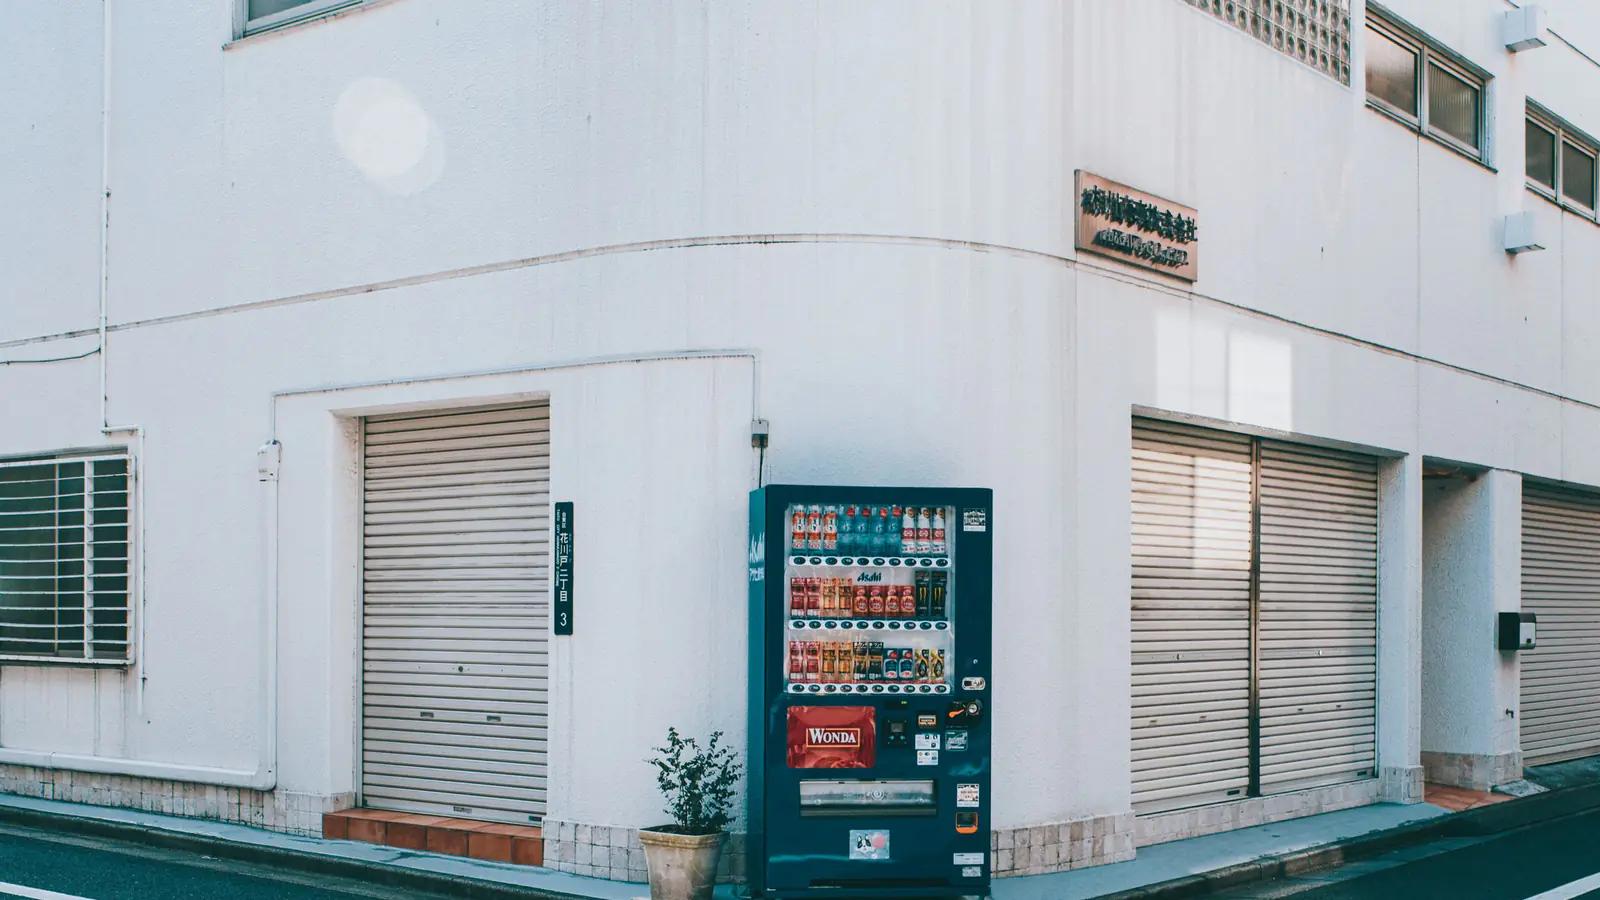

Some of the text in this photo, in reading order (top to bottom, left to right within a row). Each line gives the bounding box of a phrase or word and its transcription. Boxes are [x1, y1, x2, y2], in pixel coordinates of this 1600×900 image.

[559, 532, 569, 602] 花川戸二丁目
[857, 572, 882, 582] Asahi
[560, 612, 567, 627] 3
[809, 728, 856, 744] WONDA
